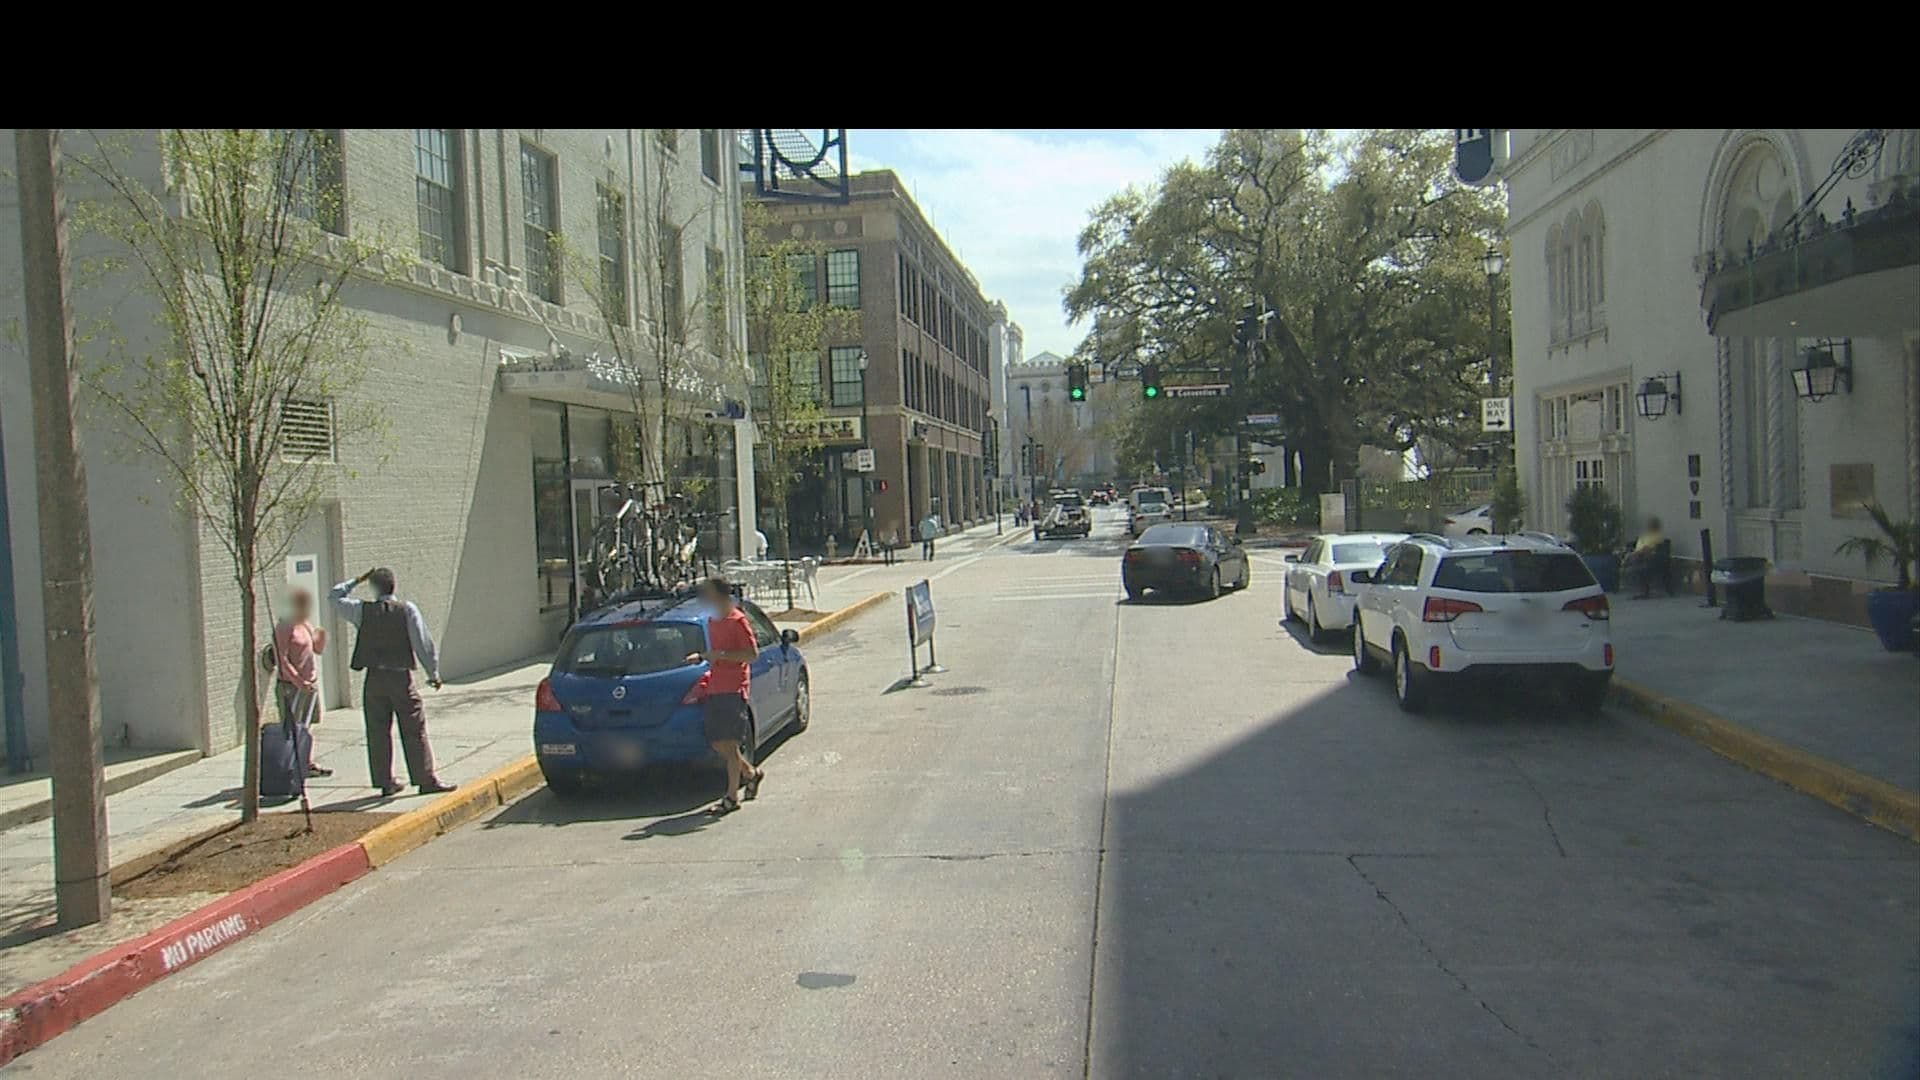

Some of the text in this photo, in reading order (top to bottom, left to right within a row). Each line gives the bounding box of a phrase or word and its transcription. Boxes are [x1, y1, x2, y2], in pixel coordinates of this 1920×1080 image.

[1486, 400, 1505, 409] ONE
[1486, 409, 1506, 418] WAY
[161, 913, 247, 969] NO PARKING
